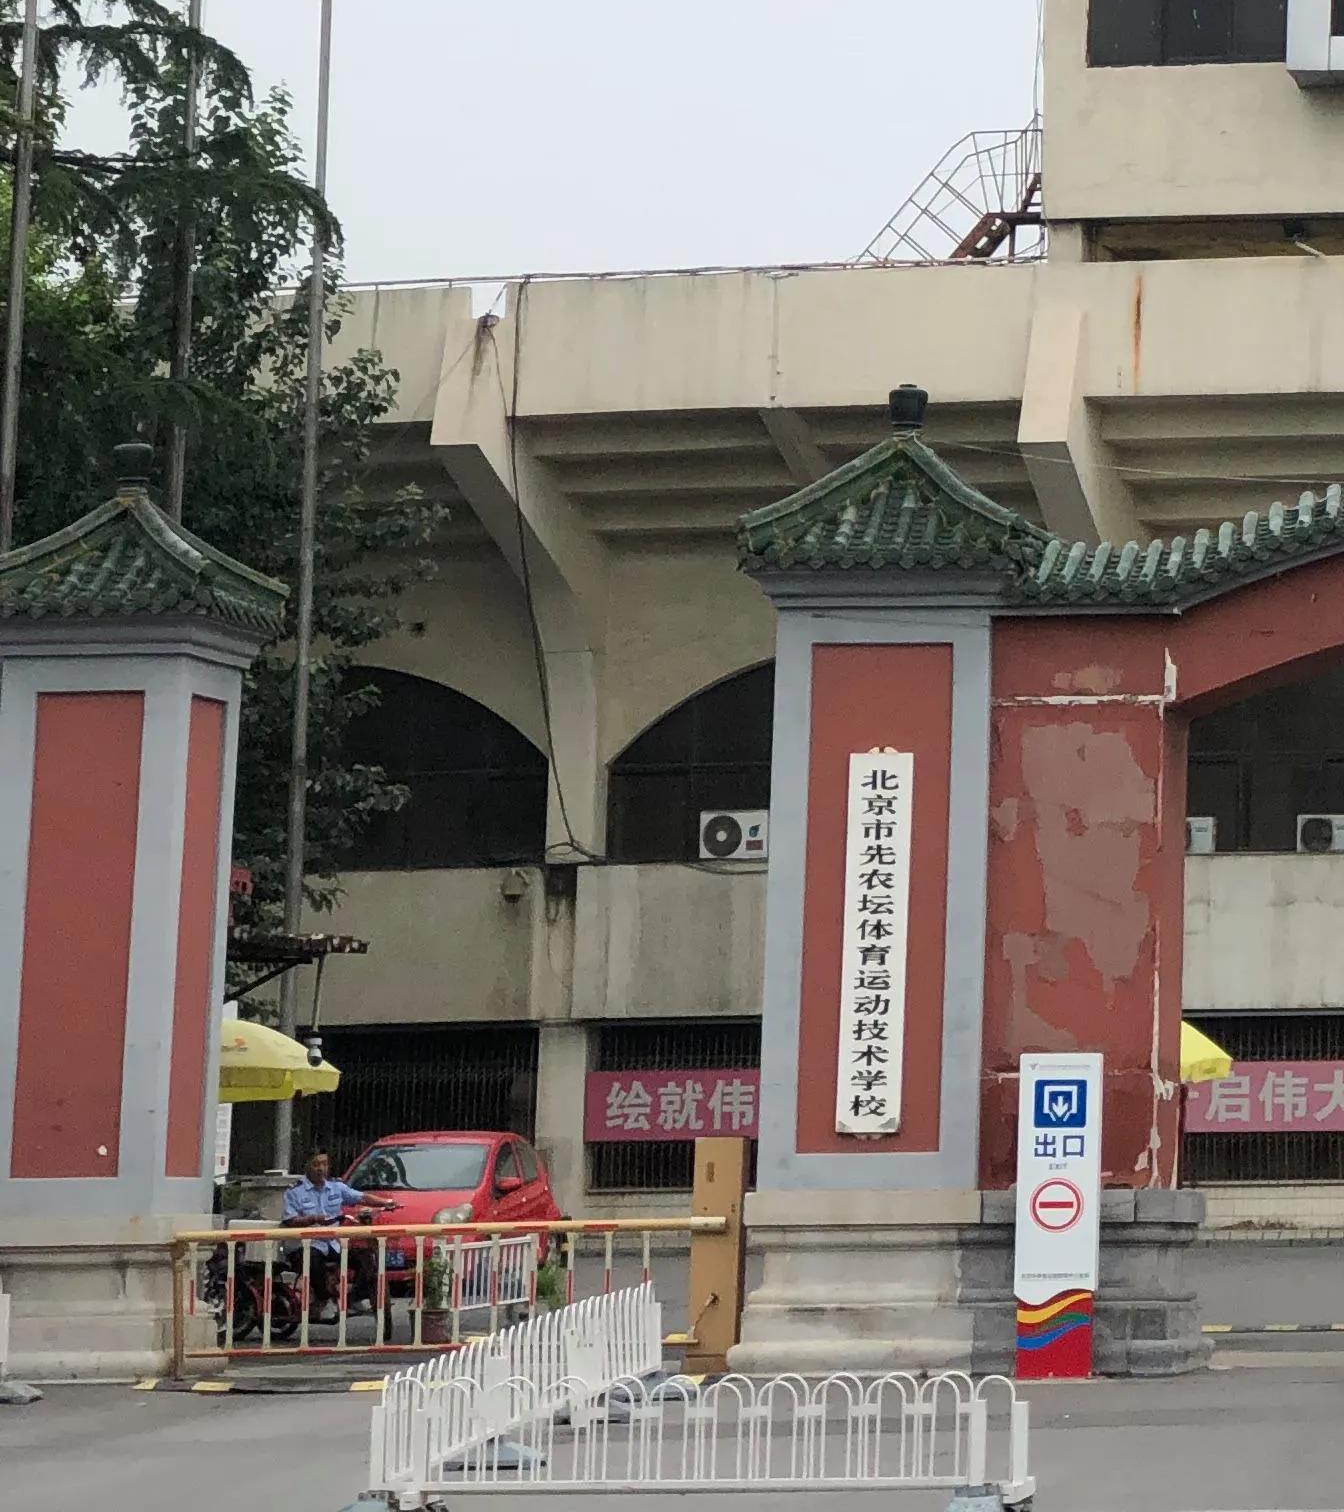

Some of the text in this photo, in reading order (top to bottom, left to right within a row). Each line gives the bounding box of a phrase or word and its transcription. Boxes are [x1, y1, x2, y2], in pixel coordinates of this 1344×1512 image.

[849, 769, 900, 1117] 北京市先农坛体育运动技术学校
[605, 1078, 756, 1131] 绘就伟
[1034, 1133, 1085, 1158] 出口
